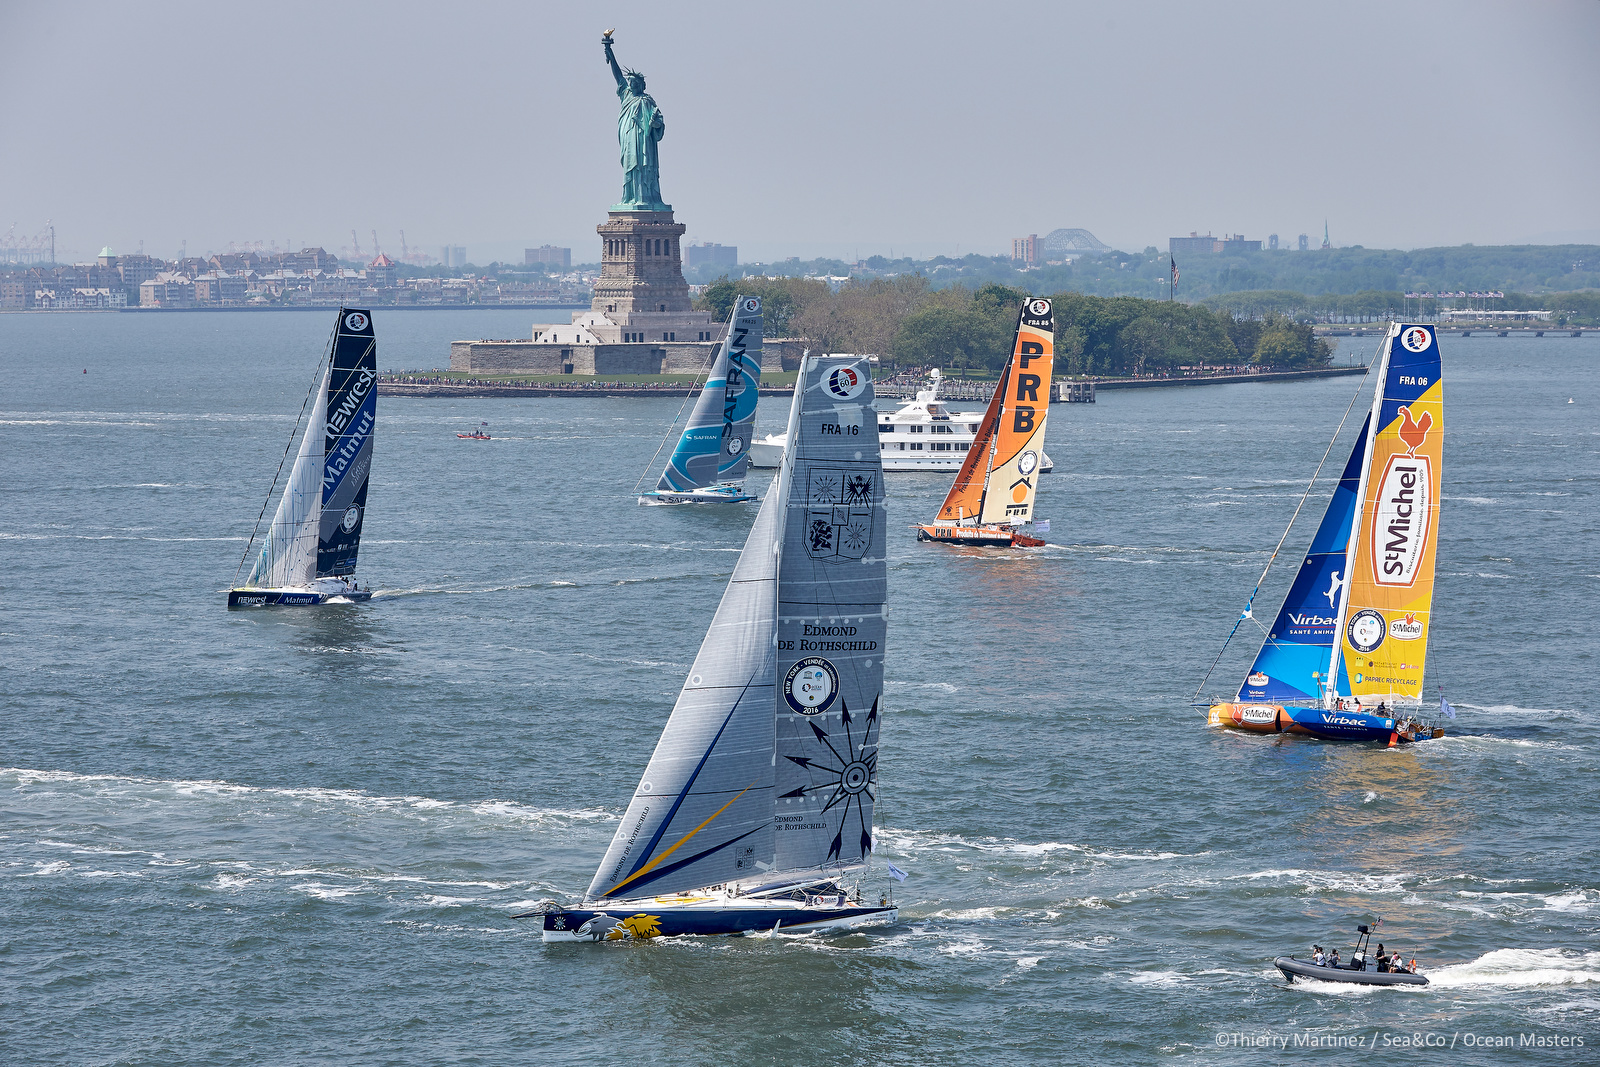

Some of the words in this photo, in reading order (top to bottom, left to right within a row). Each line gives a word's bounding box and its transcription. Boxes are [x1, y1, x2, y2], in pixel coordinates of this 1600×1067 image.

[721, 328, 748, 438] SAFRAN
[1399, 376, 1416, 385] FRA
[1418, 377, 1428, 386] 06
[822, 424, 841, 434] FRA
[846, 424, 859, 436] 16
[323, 410, 374, 490] Matmut
[803, 625, 857, 636] EDMOND
[778, 641, 794, 650] DE
[800, 639, 877, 650] ROTHSCHILD
[1322, 714, 1366, 726] Virbac
[610, 856, 626, 882] EDMOND
[624, 846, 631, 856] DE
[628, 806, 650, 845] ROTHSCHILD
